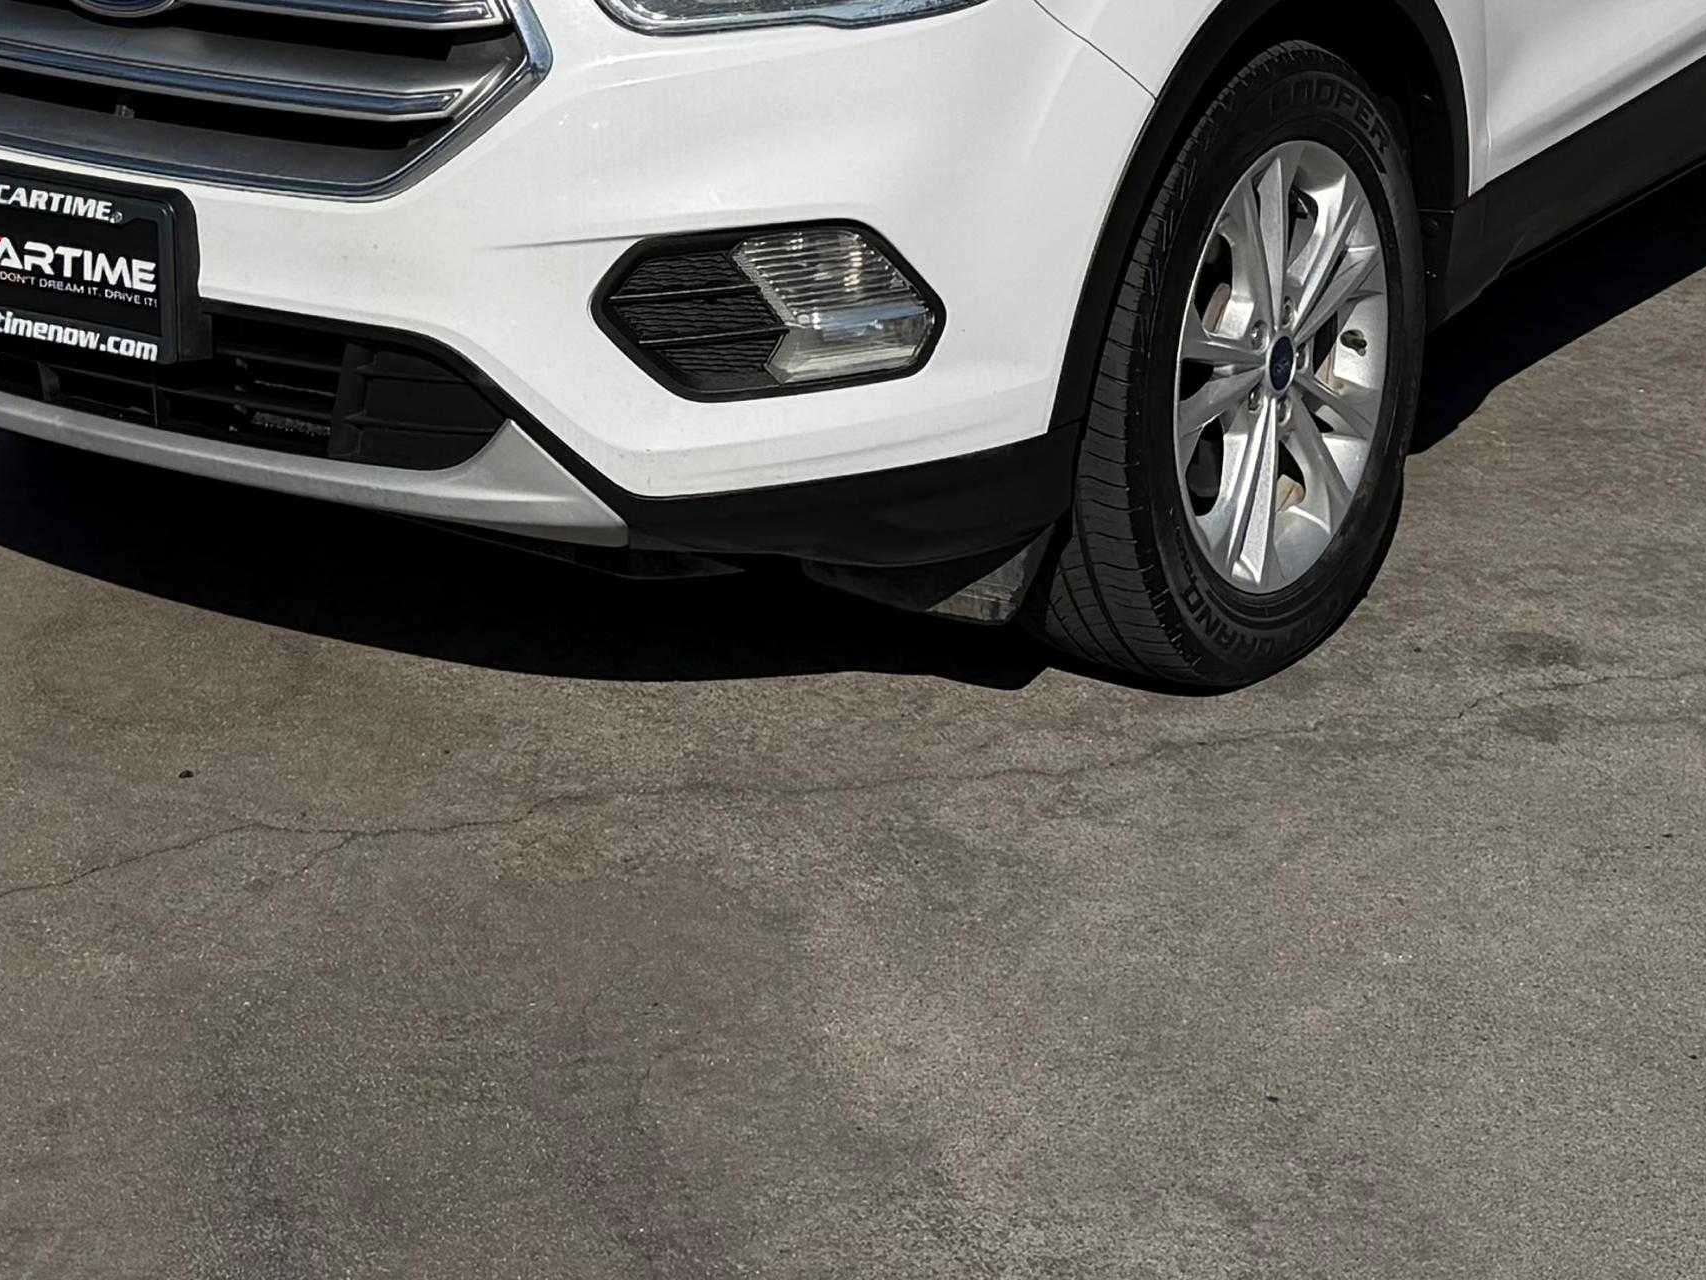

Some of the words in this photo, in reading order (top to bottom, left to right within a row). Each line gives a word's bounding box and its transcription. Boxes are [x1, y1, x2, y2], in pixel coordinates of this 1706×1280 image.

[0, 270, 36, 286] DON'T
[39, 277, 85, 294] DREAM
[104, 288, 142, 305] DRIVE
